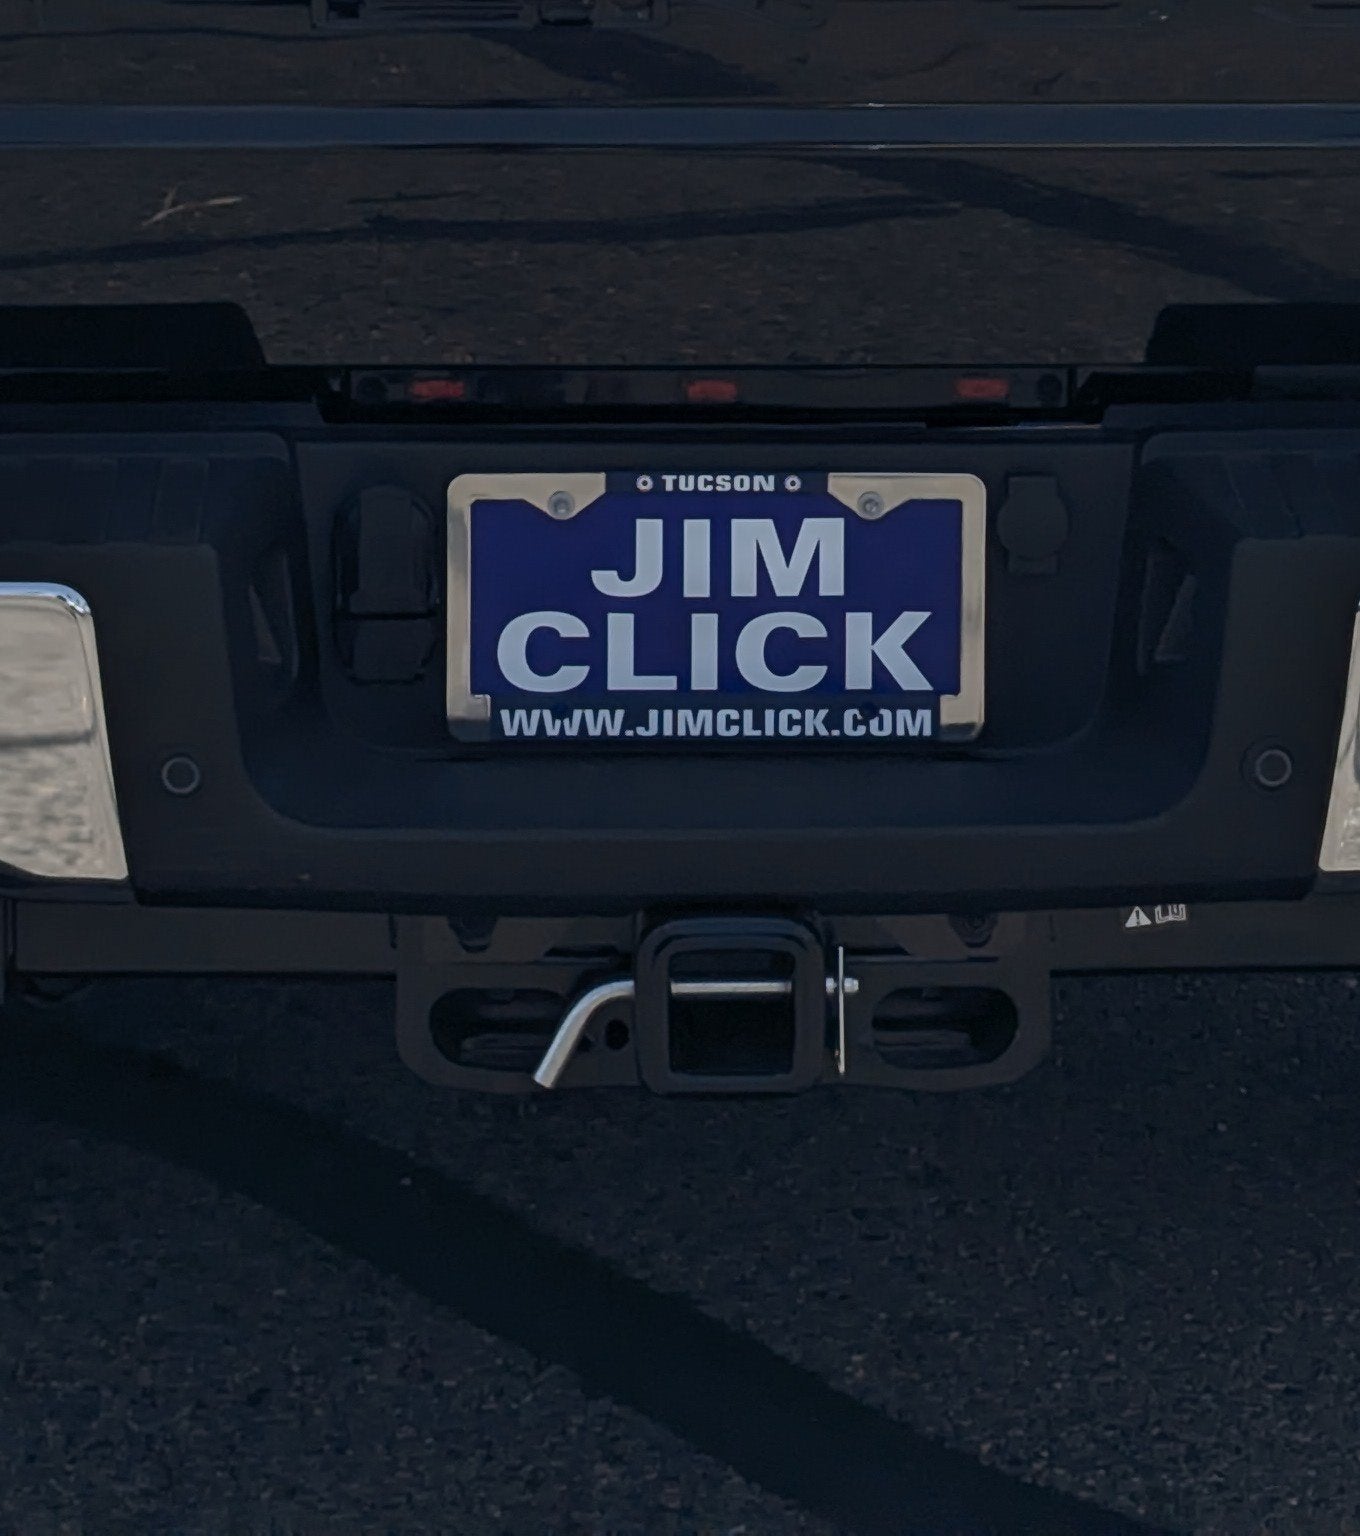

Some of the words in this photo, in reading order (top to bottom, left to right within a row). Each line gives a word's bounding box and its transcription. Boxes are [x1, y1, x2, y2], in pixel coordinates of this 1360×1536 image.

[661, 474, 776, 493] TUCSON
[590, 517, 846, 598] JIM
[496, 610, 934, 693] CLICK
[499, 708, 933, 738] WWW.JIMCLICK.COM
